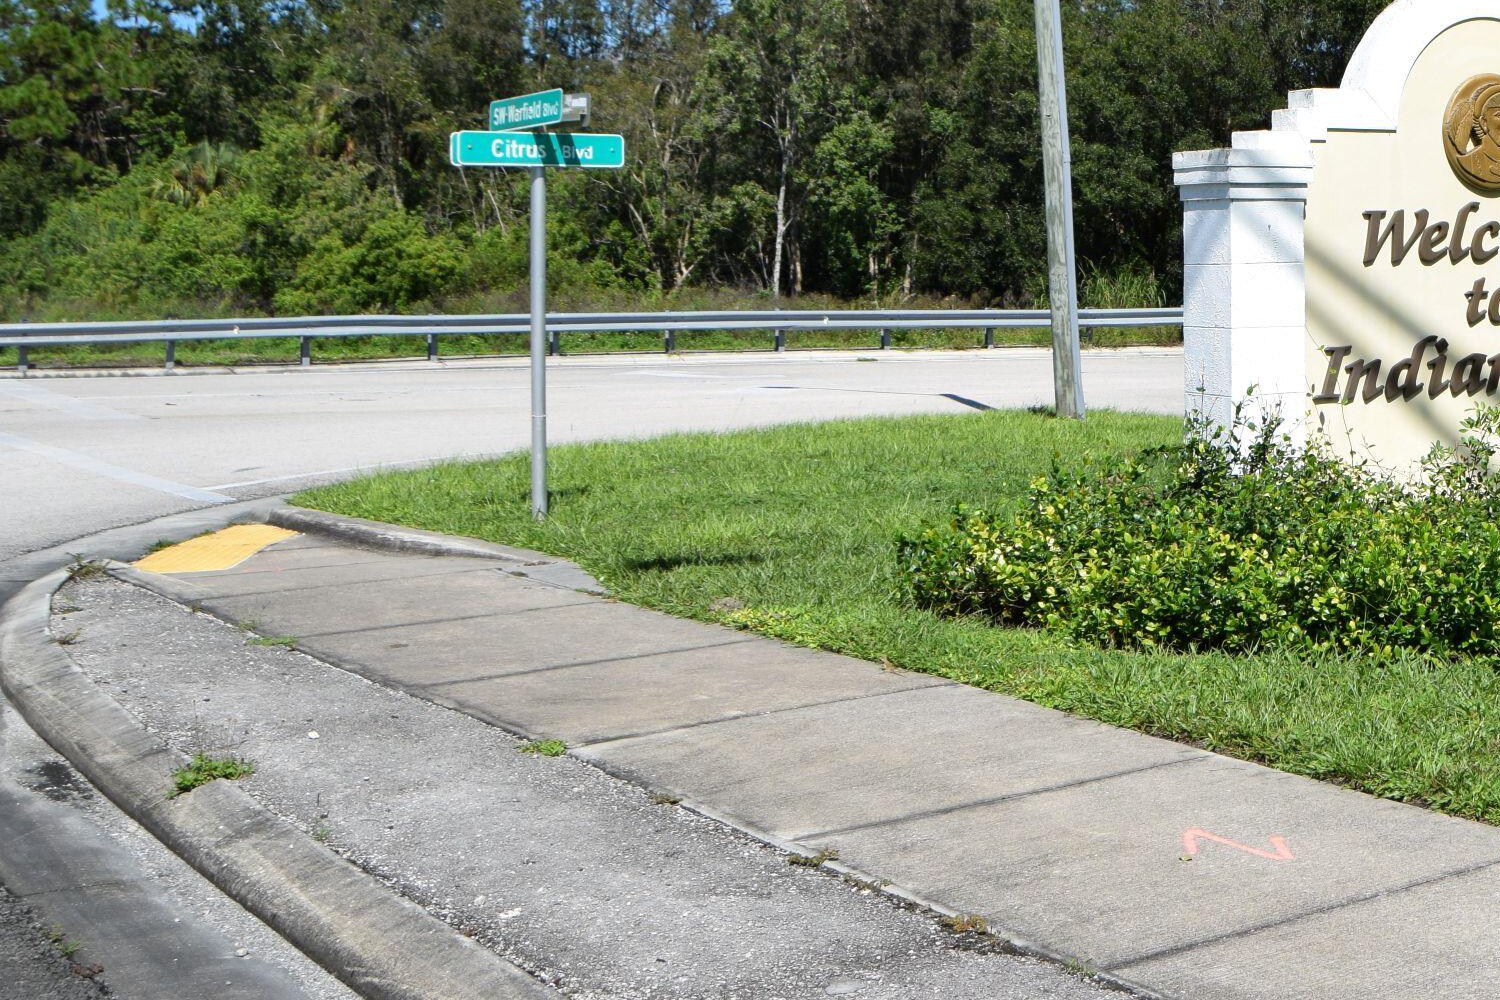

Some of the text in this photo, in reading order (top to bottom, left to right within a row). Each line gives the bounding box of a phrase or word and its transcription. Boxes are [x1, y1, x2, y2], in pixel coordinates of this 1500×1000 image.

[507, 101, 541, 122] Warfield
[543, 102, 559, 117] Blvd
[491, 138, 593, 159] Citrus Blvd
